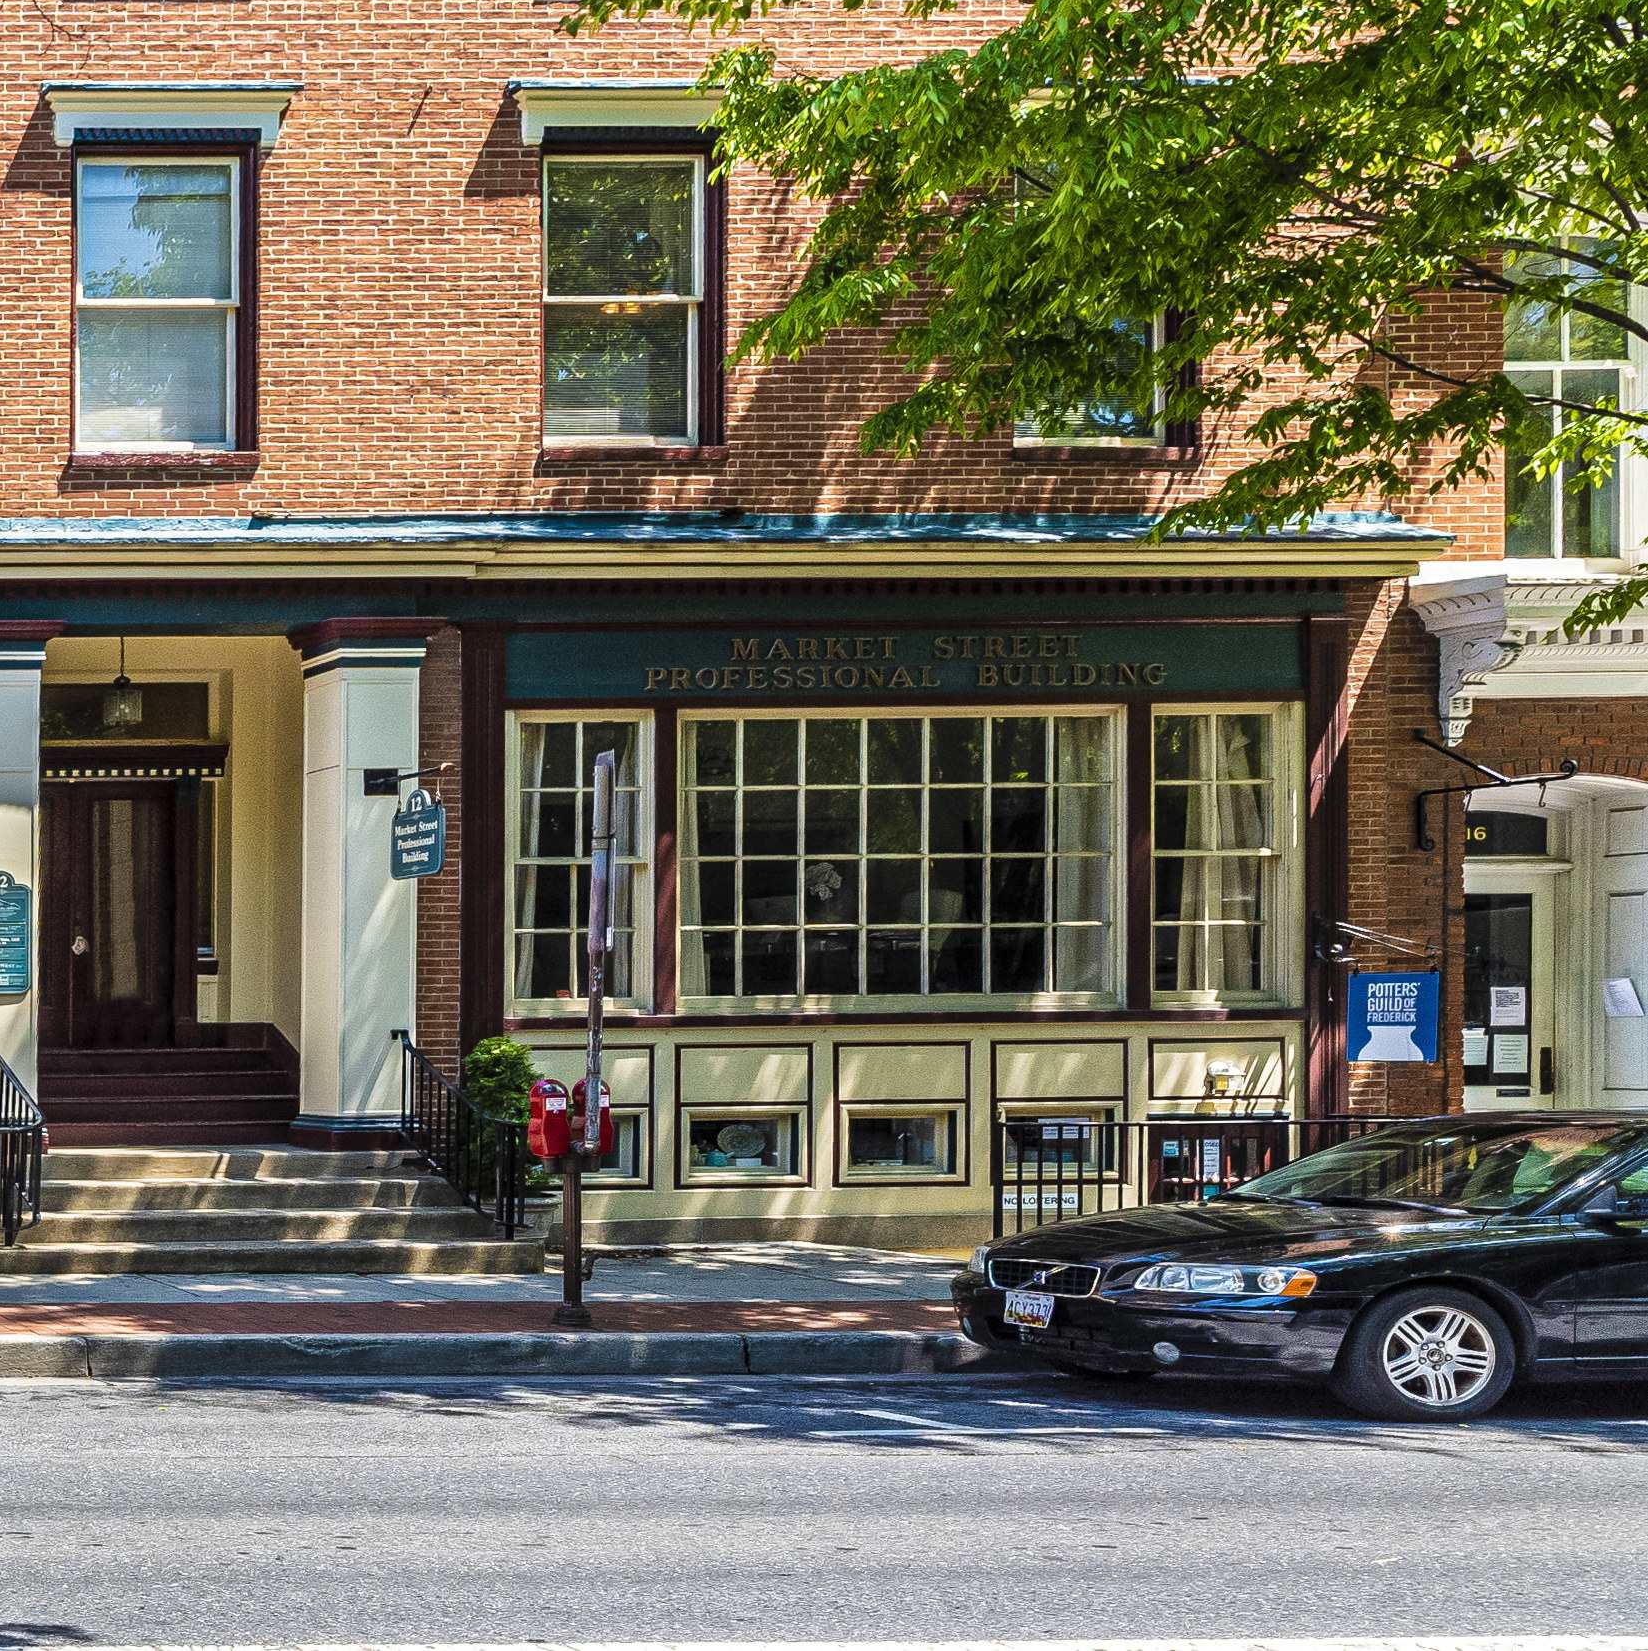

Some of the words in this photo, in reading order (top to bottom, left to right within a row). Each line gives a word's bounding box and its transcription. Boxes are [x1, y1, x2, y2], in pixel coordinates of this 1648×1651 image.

[730, 636, 898, 662] MARKET
[933, 634, 1083, 659] STREET
[644, 664, 941, 690] PROFESSIONAL
[976, 662, 1168, 687] BUILDING
[411, 796, 423, 812] 12
[395, 824, 417, 836] Market
[418, 819, 438, 832] Street
[1466, 826, 1487, 841] 16
[397, 834, 435, 851] Professional
[402, 851, 429, 863] Building
[1368, 982, 1421, 998] POTTERS'
[1367, 997, 1402, 1012] GUILD
[1403, 997, 1417, 1008] OF
[1367, 1011, 1417, 1023] FREDERICK
[1004, 1197, 1018, 1205] NO
[1023, 1196, 1075, 1205] LOERNG
